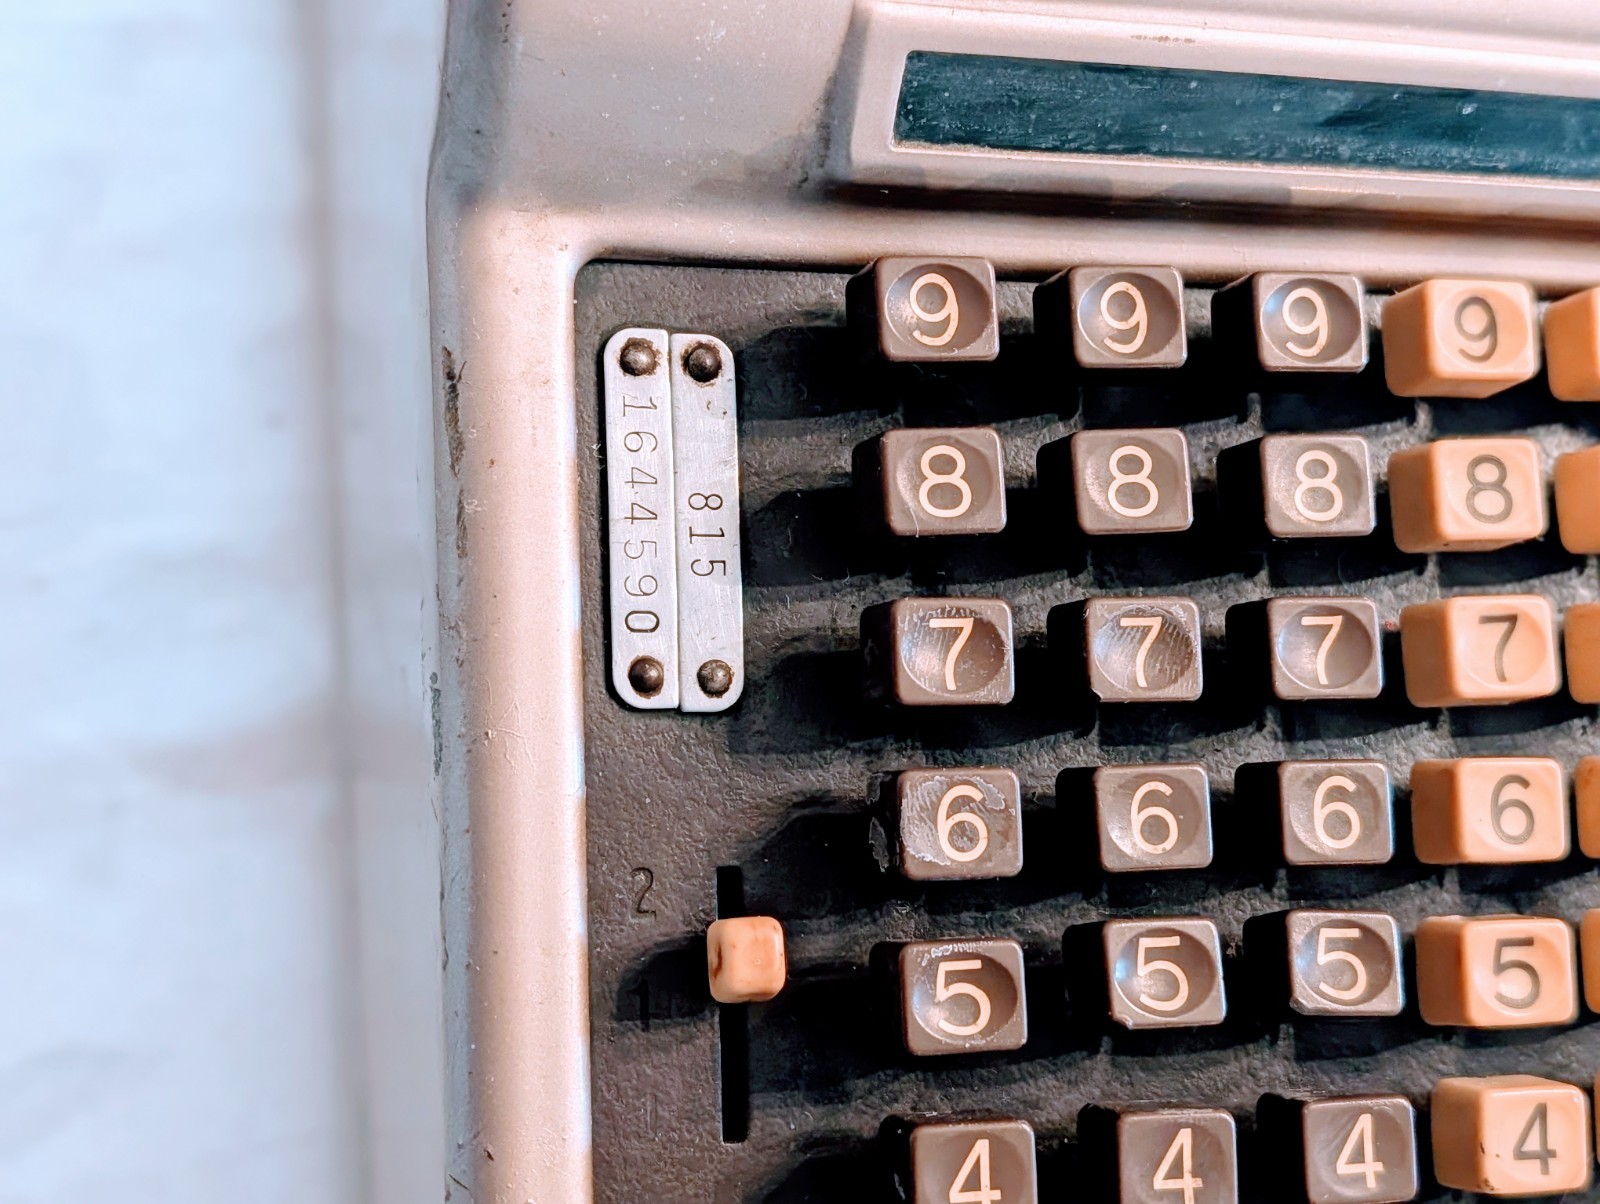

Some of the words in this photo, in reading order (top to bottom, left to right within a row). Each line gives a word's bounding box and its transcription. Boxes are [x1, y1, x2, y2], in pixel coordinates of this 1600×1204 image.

[909, 273, 959, 346] 9
[1100, 282, 1148, 353] 9
[1282, 288, 1329, 357] 9
[1454, 296, 1499, 362] 9
[623, 396, 660, 634] 1644590
[918, 445, 972, 517] 8
[1107, 445, 1159, 517] 8
[1294, 450, 1343, 521] 8
[1466, 454, 1513, 523] 8
[687, 492, 726, 577] 815
[928, 617, 974, 691] 7
[1118, 616, 1162, 688] 7
[1301, 615, 1344, 684] 7
[1478, 614, 1518, 682] 7
[936, 784, 988, 862] 6
[1130, 781, 1178, 854] 6
[1313, 776, 1361, 849] 6
[1491, 774, 1535, 845] 6
[630, 866, 657, 917] 2
[934, 959, 991, 1035] 5
[1135, 936, 1189, 1011] 5
[1317, 928, 1367, 1000] 5
[1493, 937, 1541, 1009] 5
[949, 1139, 1001, 1204] 4
[1153, 1128, 1202, 1204] 4
[1336, 1113, 1384, 1188] 4
[1513, 1102, 1557, 1175] 4
